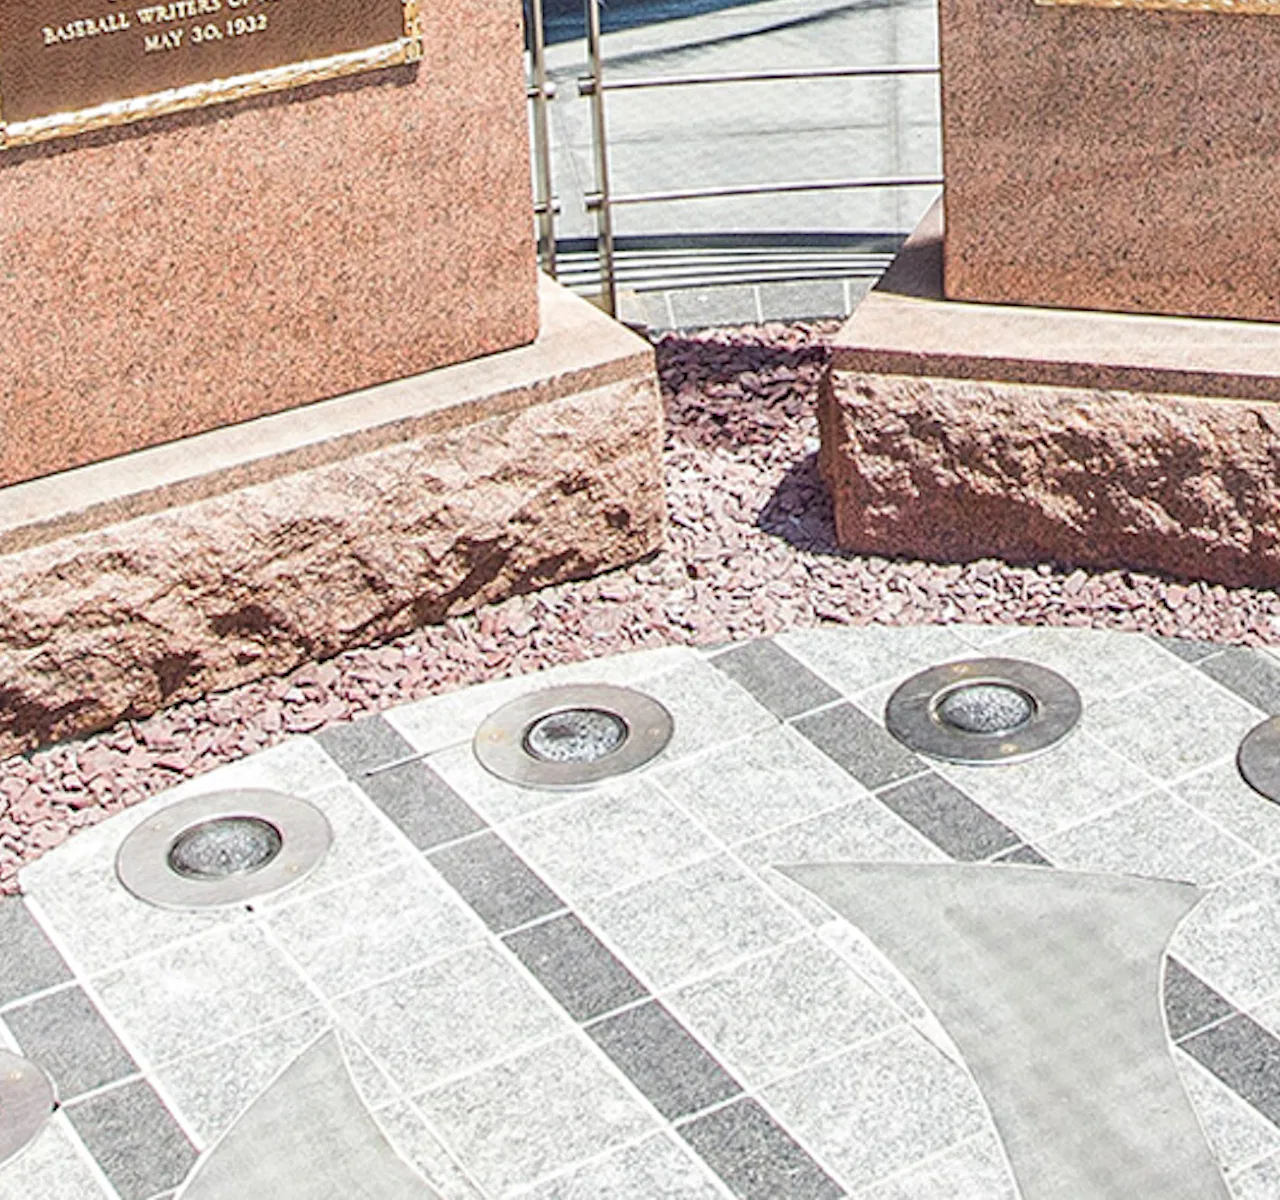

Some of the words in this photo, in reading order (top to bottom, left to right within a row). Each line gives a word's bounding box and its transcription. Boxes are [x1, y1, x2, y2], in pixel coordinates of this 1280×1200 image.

[41, 11, 131, 46] BASEBALL
[144, 28, 185, 53] MAY
[226, 13, 269, 38] 1932
